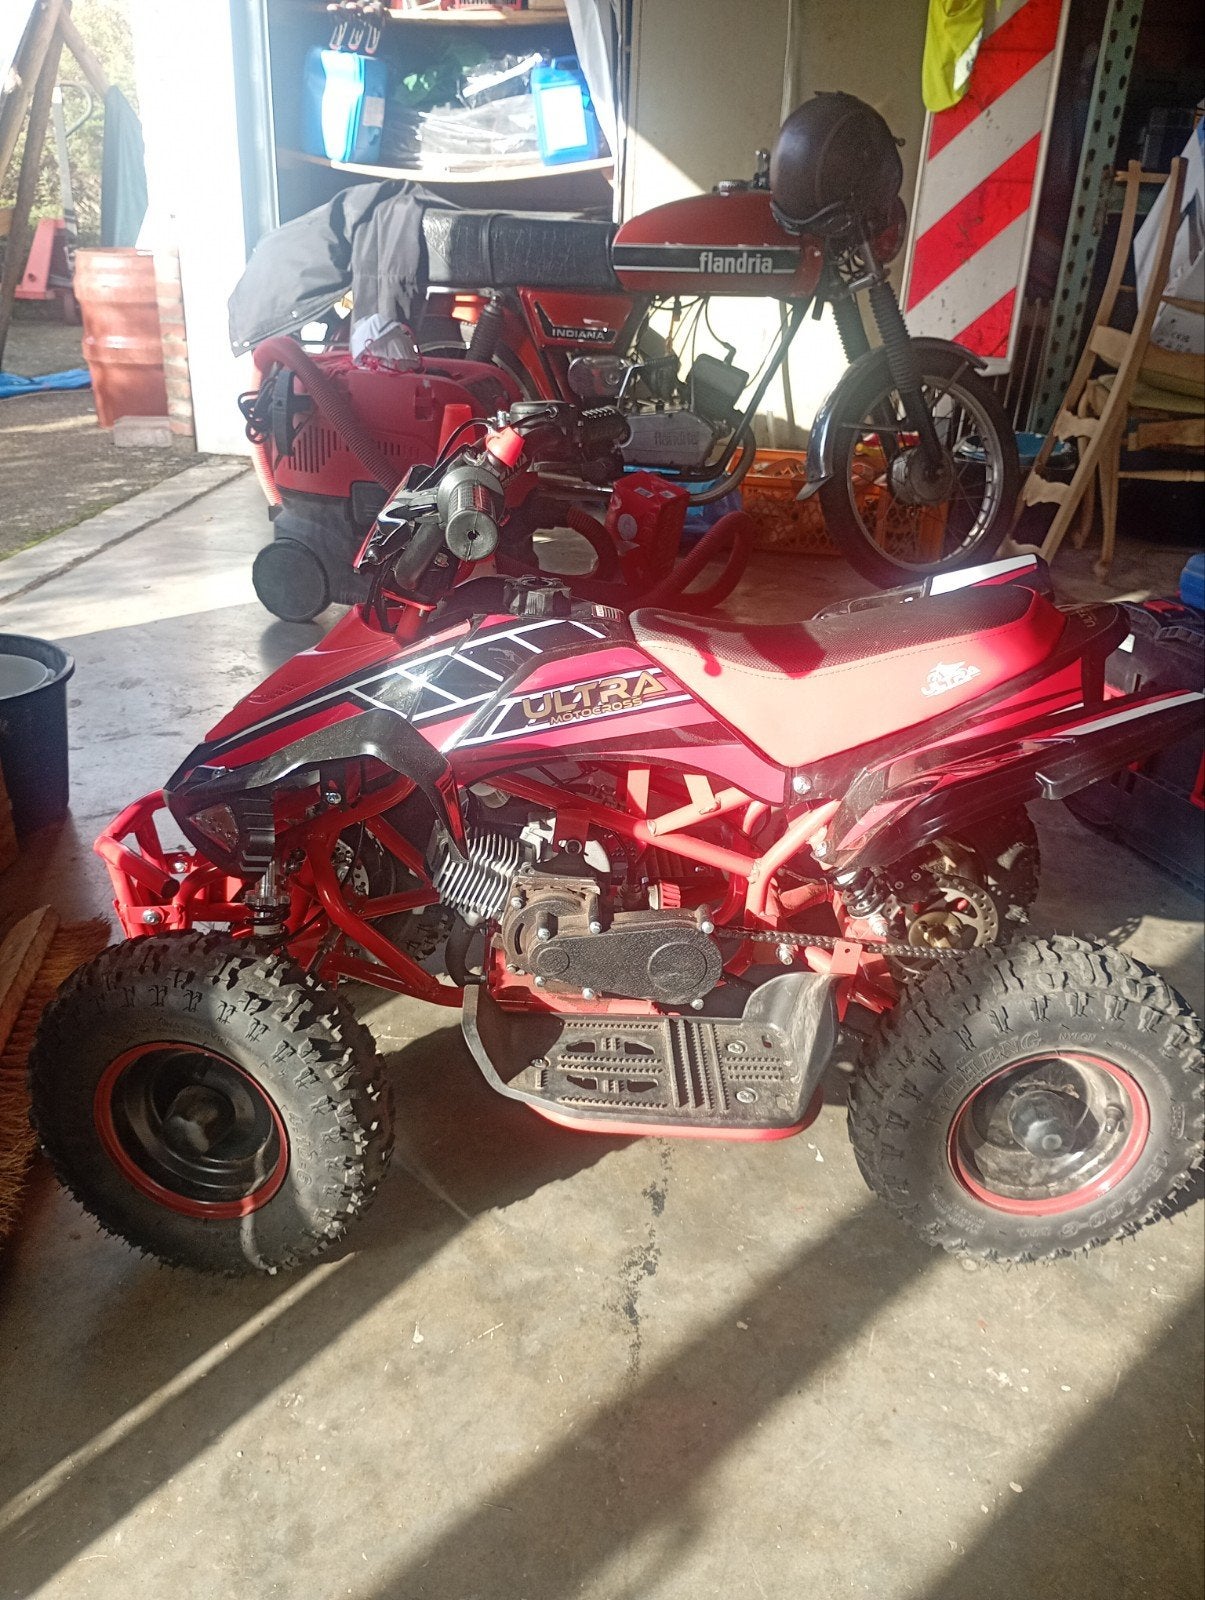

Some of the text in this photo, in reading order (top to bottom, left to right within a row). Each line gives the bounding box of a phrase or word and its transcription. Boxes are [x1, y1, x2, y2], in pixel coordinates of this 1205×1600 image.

[699, 251, 774, 274] flandria
[552, 328, 605, 340] INDIANA
[522, 670, 668, 720] ULTRA
[550, 696, 644, 725] MOTOCROSS
[1058, 1031, 1098, 1043] NYLON
